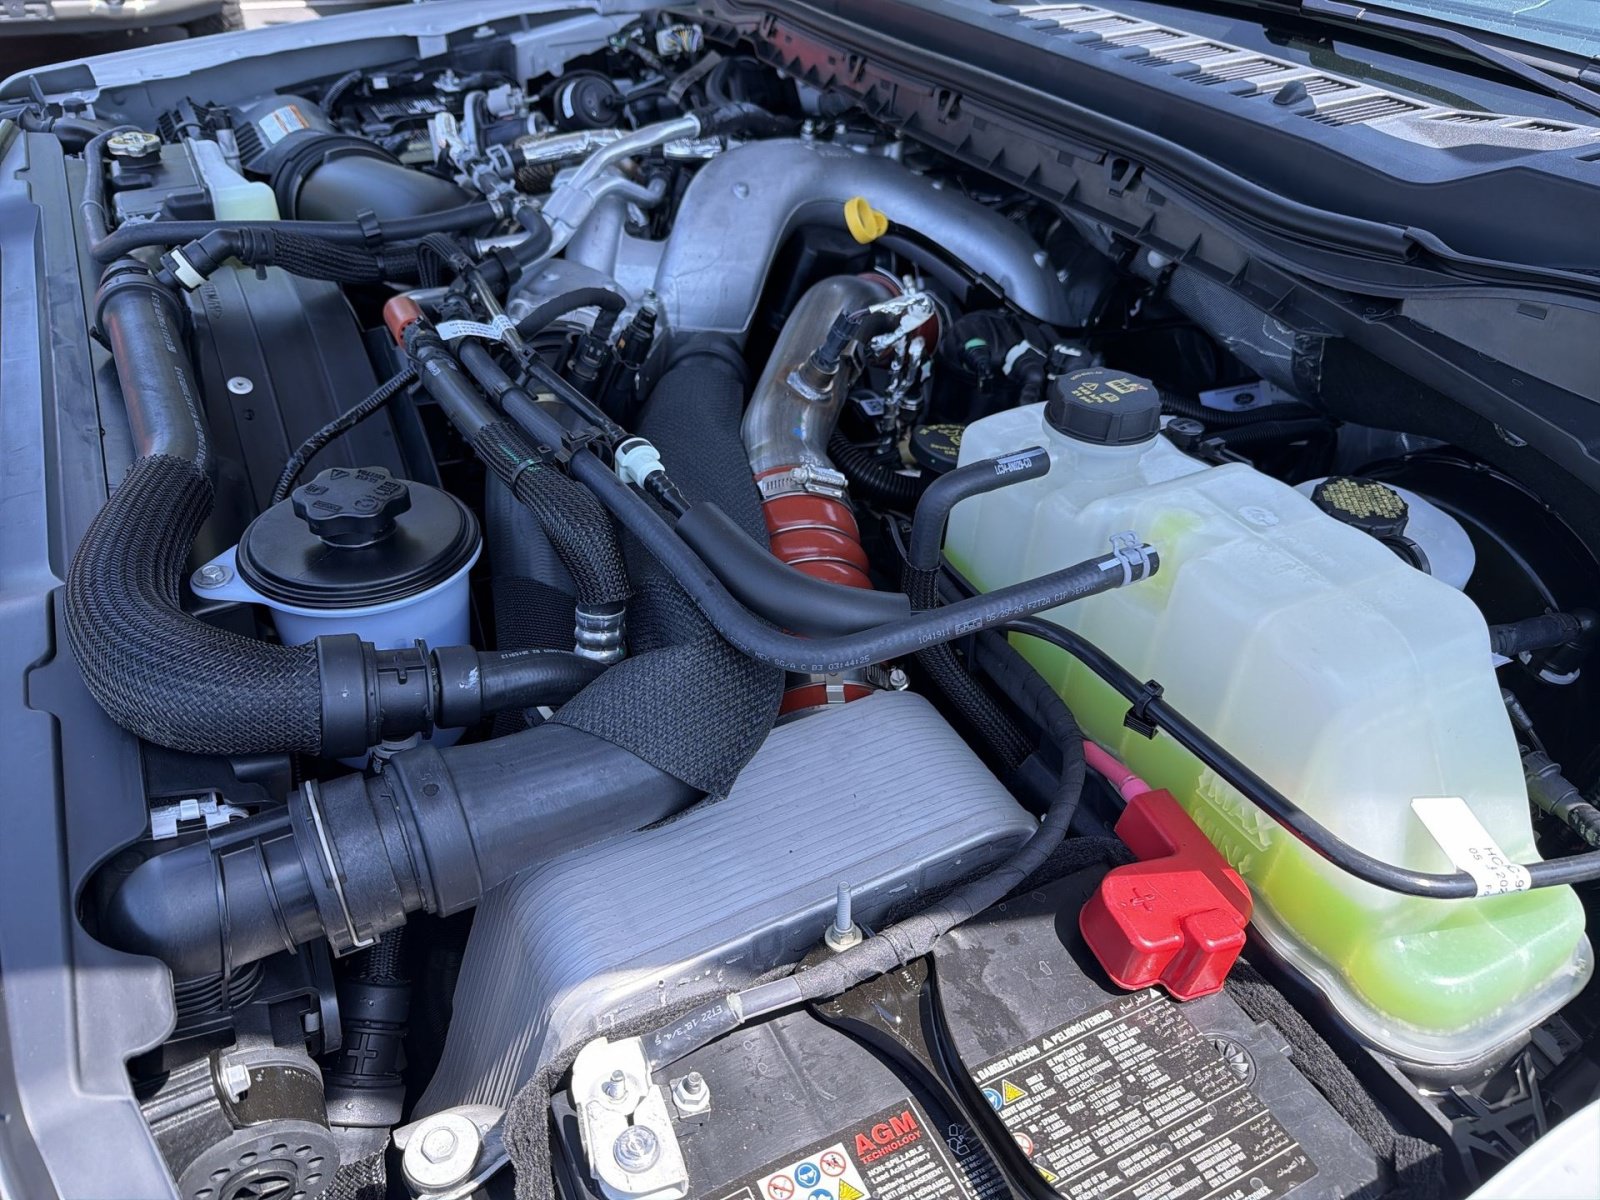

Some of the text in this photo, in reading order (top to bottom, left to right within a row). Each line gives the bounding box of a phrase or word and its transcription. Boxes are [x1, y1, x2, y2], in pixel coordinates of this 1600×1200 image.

[1049, 1009, 1114, 1045] PELIGRO/VENENO
[976, 1044, 1040, 1080] DANGER/POISON
[855, 1110, 918, 1156] AGM
[860, 1130, 922, 1164] TECHNOLOGY
[867, 1145, 925, 1178] NON-SPILLABLE
[871, 1152, 930, 1184] Lead Acid Battery
[904, 1173, 915, 1181] au
